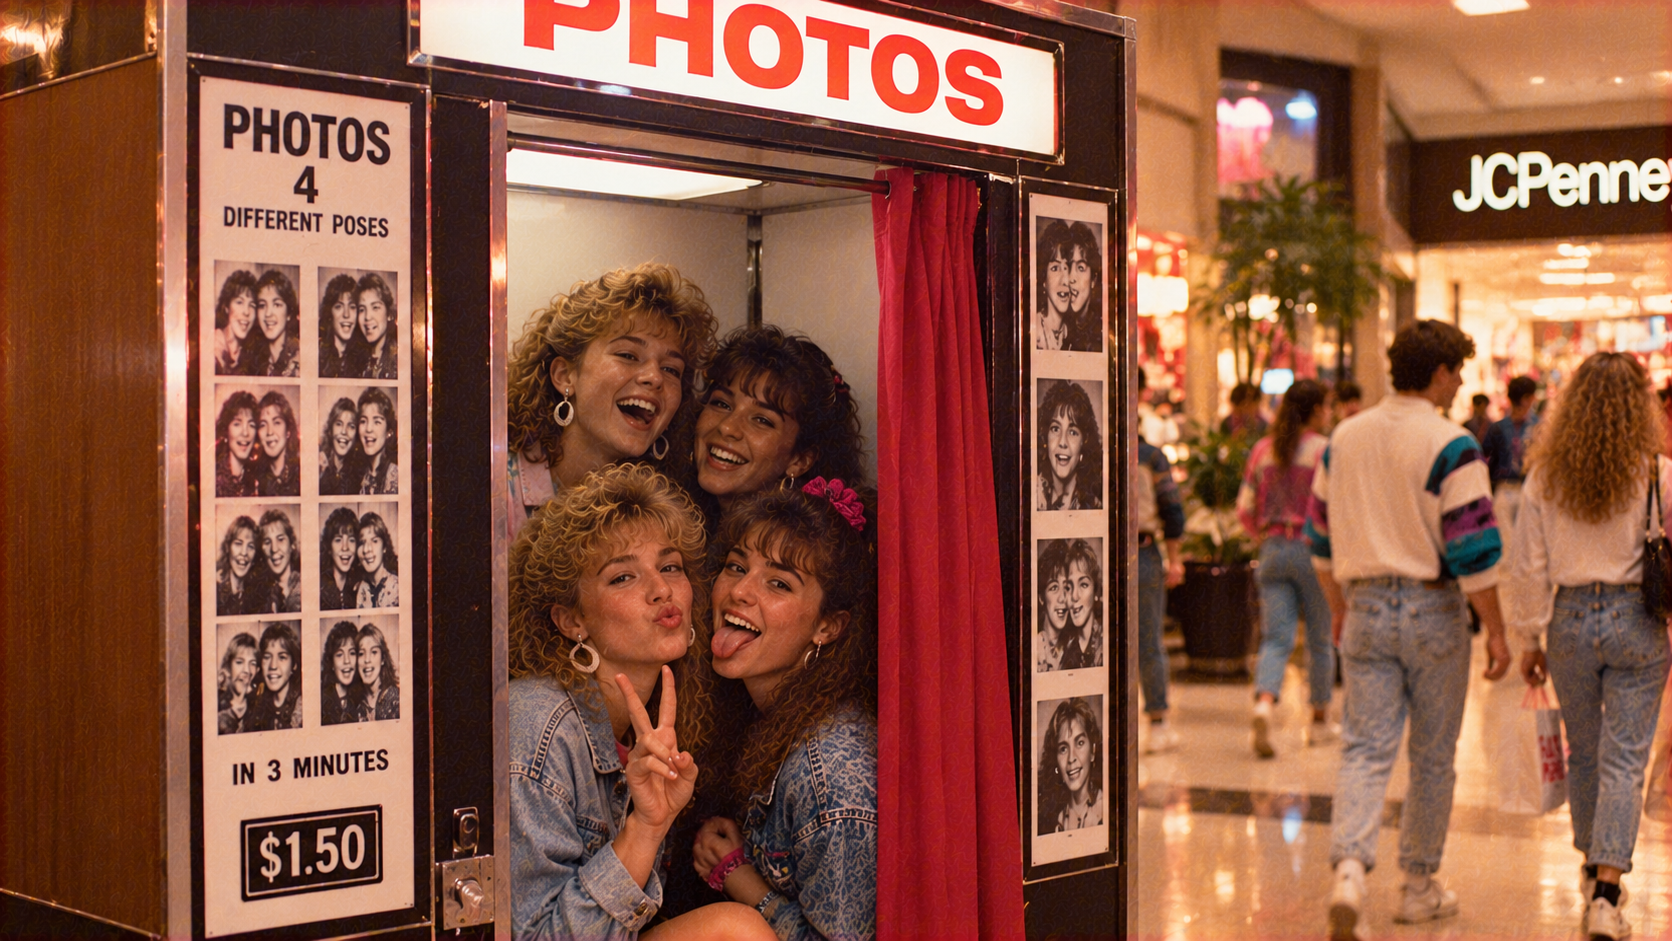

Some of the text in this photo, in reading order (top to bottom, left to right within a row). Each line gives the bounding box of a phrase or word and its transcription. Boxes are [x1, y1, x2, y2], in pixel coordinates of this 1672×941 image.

[523, 0, 1004, 126] PHOTOS
[223, 103, 391, 165] PHOTOS
[293, 165, 319, 204] 4
[1452, 151, 1672, 212] JCPenne
[223, 206, 389, 238] DIFFERENT POSES
[232, 749, 389, 785] IN 3 MINUTES
[259, 824, 366, 883] $1.50
